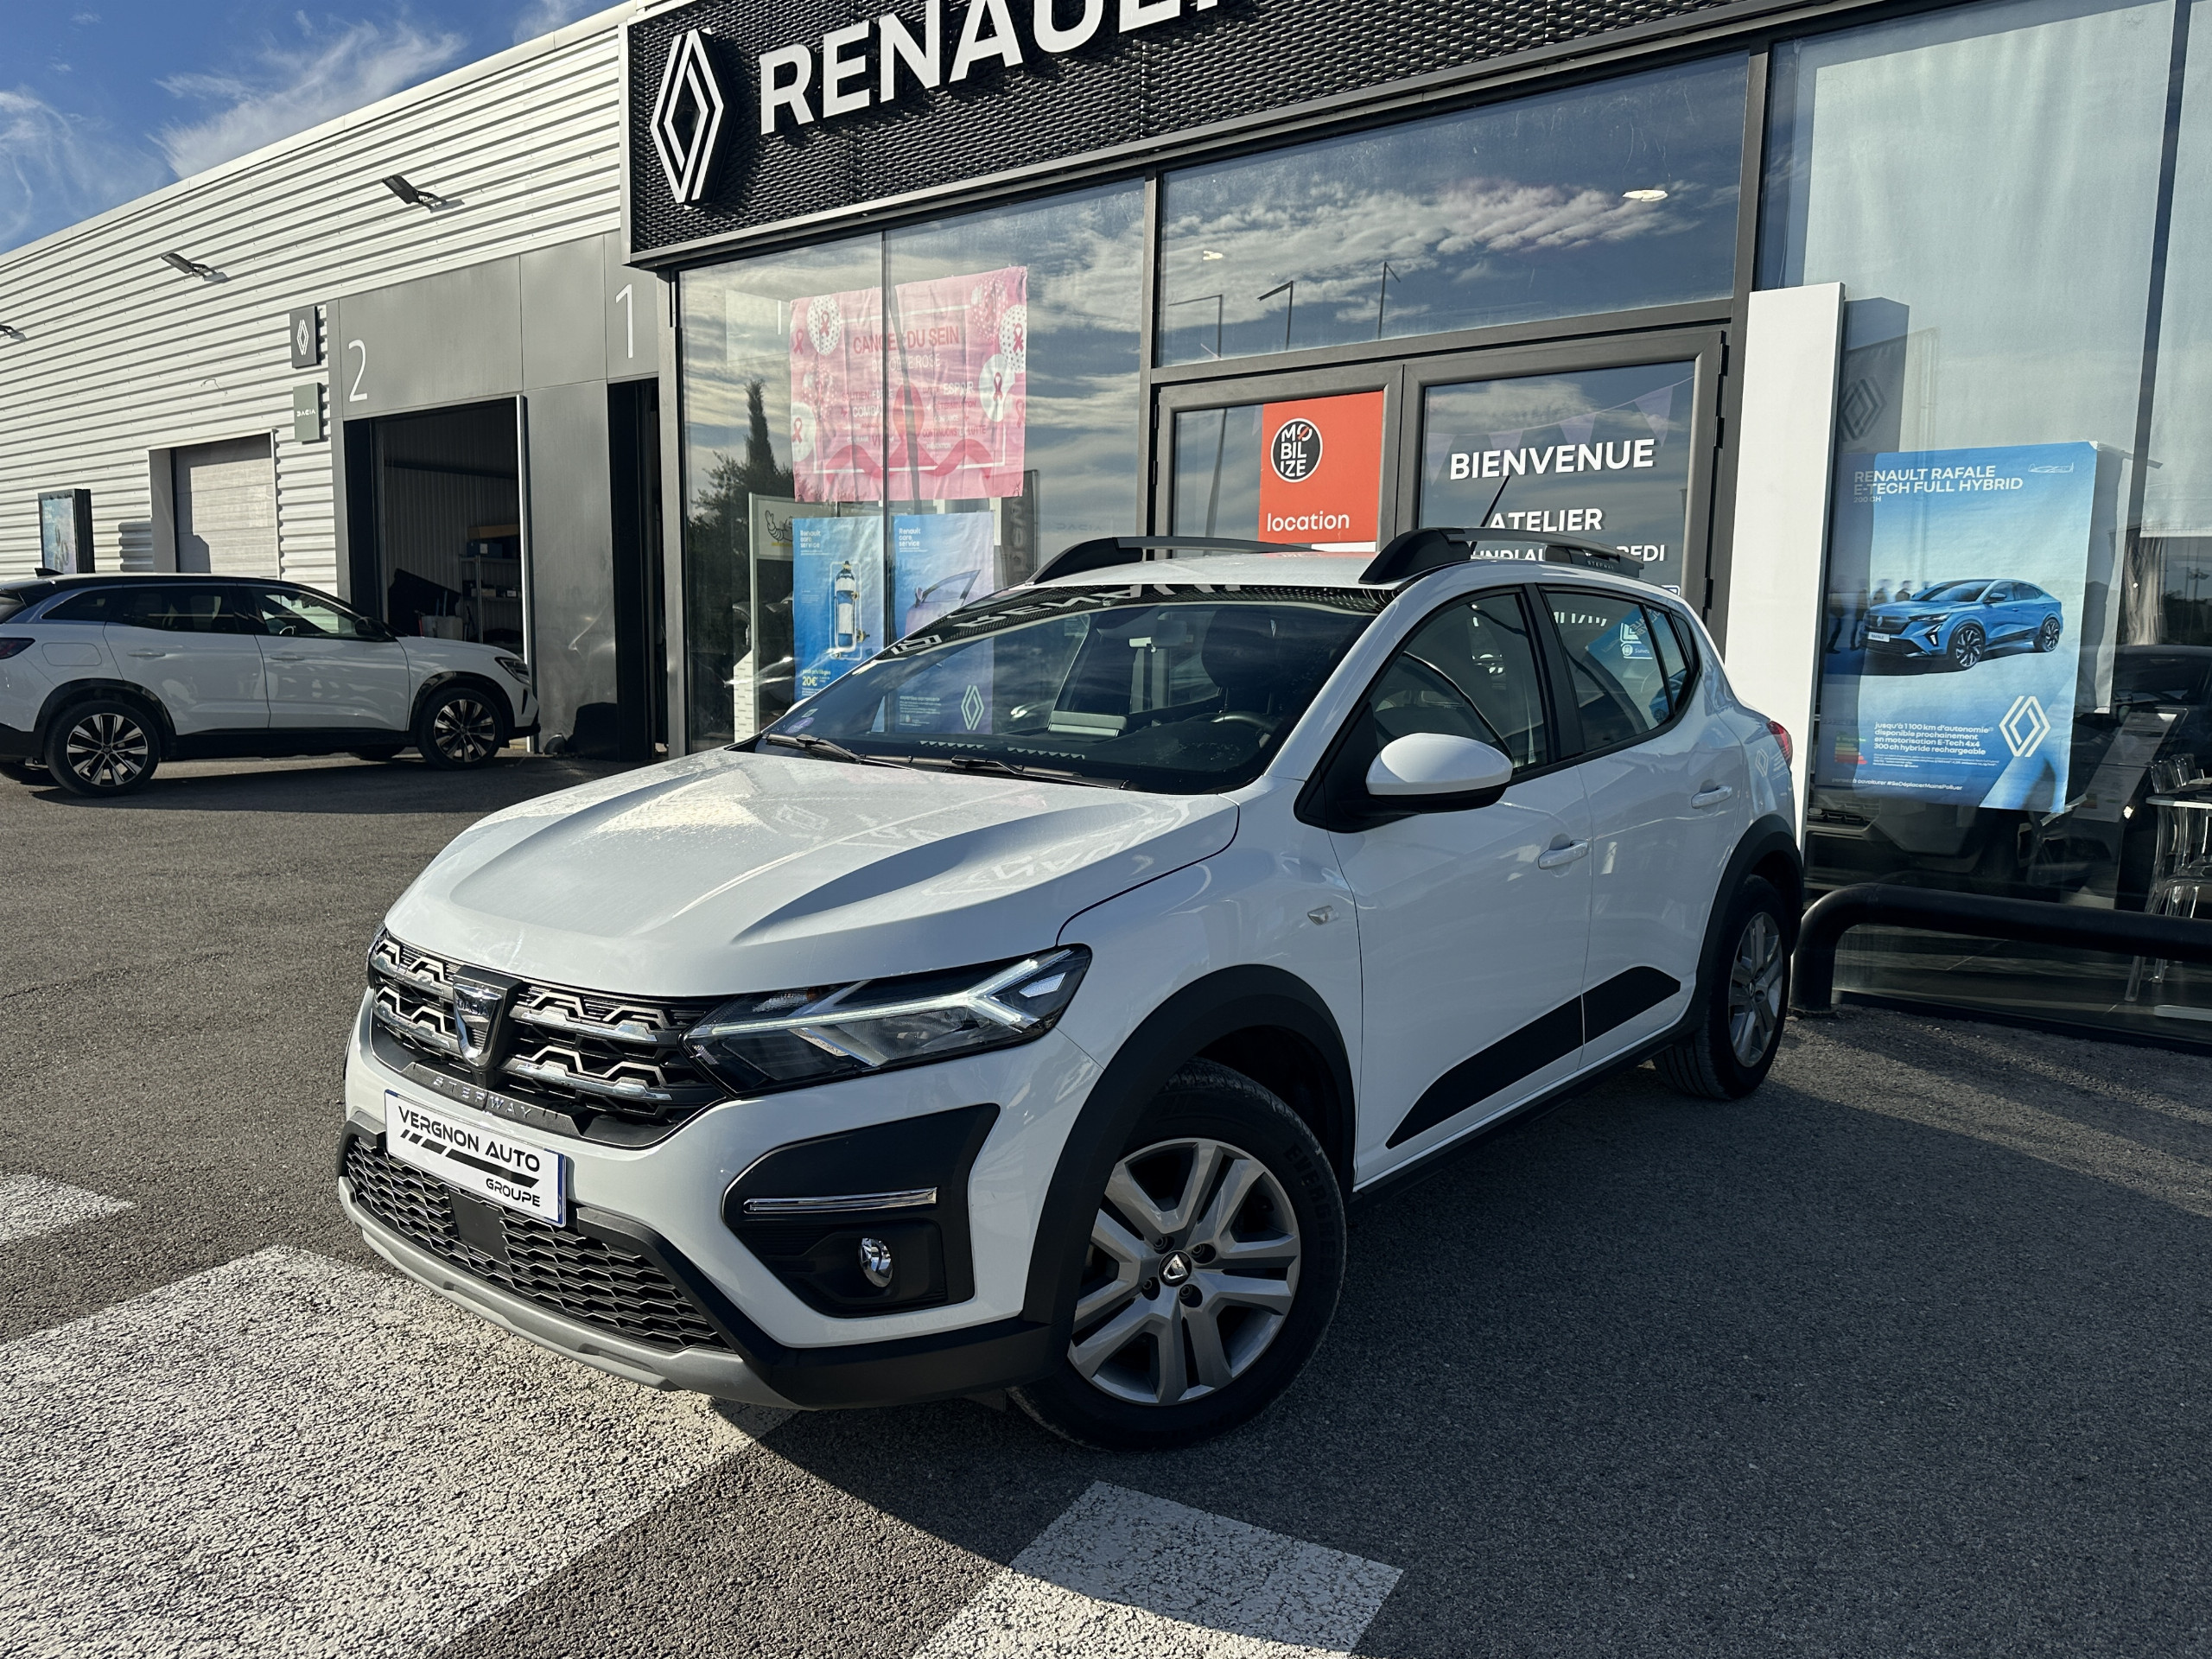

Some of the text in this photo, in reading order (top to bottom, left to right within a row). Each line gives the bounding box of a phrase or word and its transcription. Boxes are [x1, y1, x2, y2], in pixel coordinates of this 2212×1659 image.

[760, 0, 1218, 136] RENAU
[615, 283, 634, 359] 1
[853, 325, 960, 354] CANCE DU SEIN
[348, 339, 368, 403] 2
[916, 353, 941, 368] ROSE
[944, 381, 974, 397] ESPOR
[296, 408, 316, 417] DACIA
[852, 404, 882, 418] COMBA
[1450, 438, 1656, 481] BIENVENUE
[1854, 465, 1996, 483] RENAULT RAFALE
[1853, 477, 2024, 496] E-TECH FULL HYBRID
[1267, 510, 1350, 532] location
[1489, 508, 1604, 532] ATELIER
[1874, 729, 1979, 741] disponible prochainement
[1937, 739, 1965, 747] E-Tech
[1900, 744, 1930, 753] hybride
[1931, 746, 1986, 756] rechargeable
[433, 1076, 532, 1119] STEPWAY
[397, 1105, 541, 1173] VERGNON AUTO
[486, 1178, 541, 1208] GROUPE
